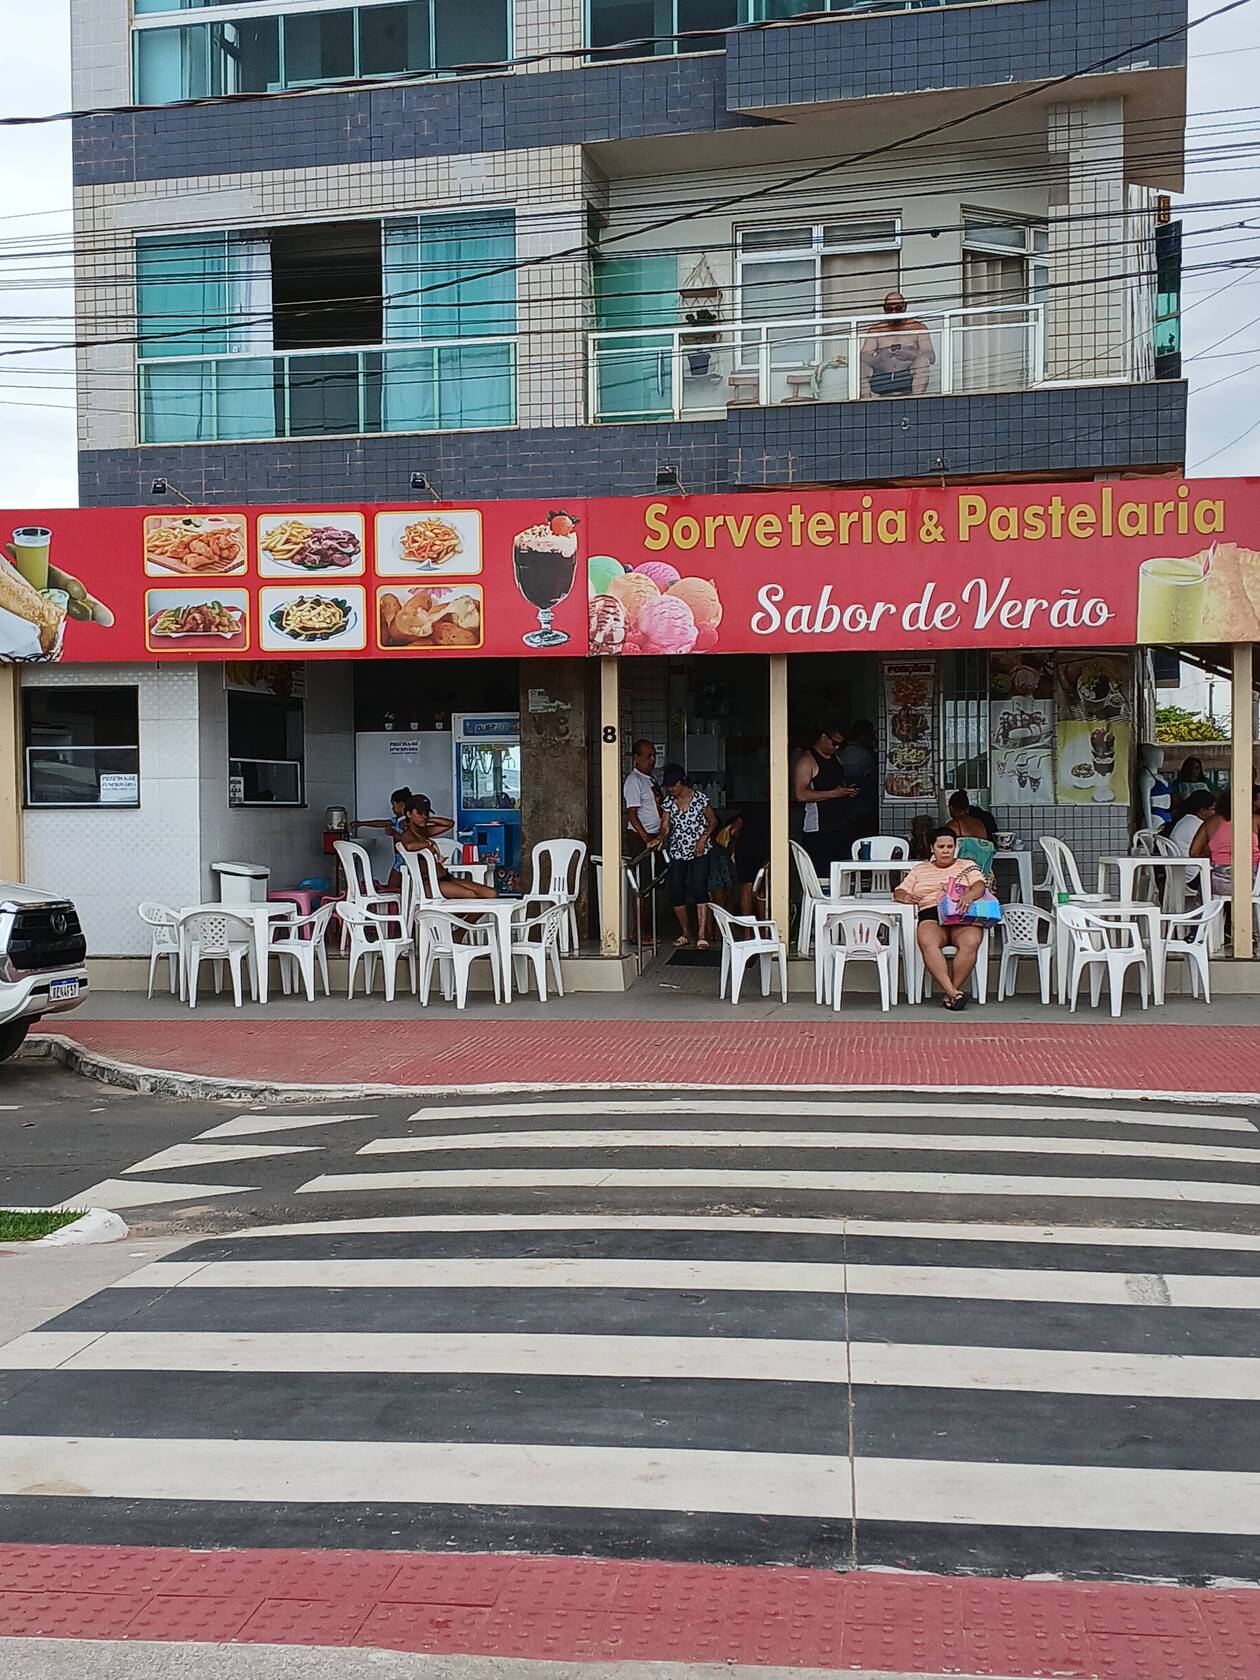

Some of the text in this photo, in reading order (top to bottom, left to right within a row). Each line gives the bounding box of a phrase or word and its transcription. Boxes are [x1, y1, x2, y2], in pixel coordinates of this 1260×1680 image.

[643, 484, 1226, 551] Sorveteria & Pastelaria
[750, 576, 1116, 636] Sabor de Verão
[602, 725, 617, 744] 8
